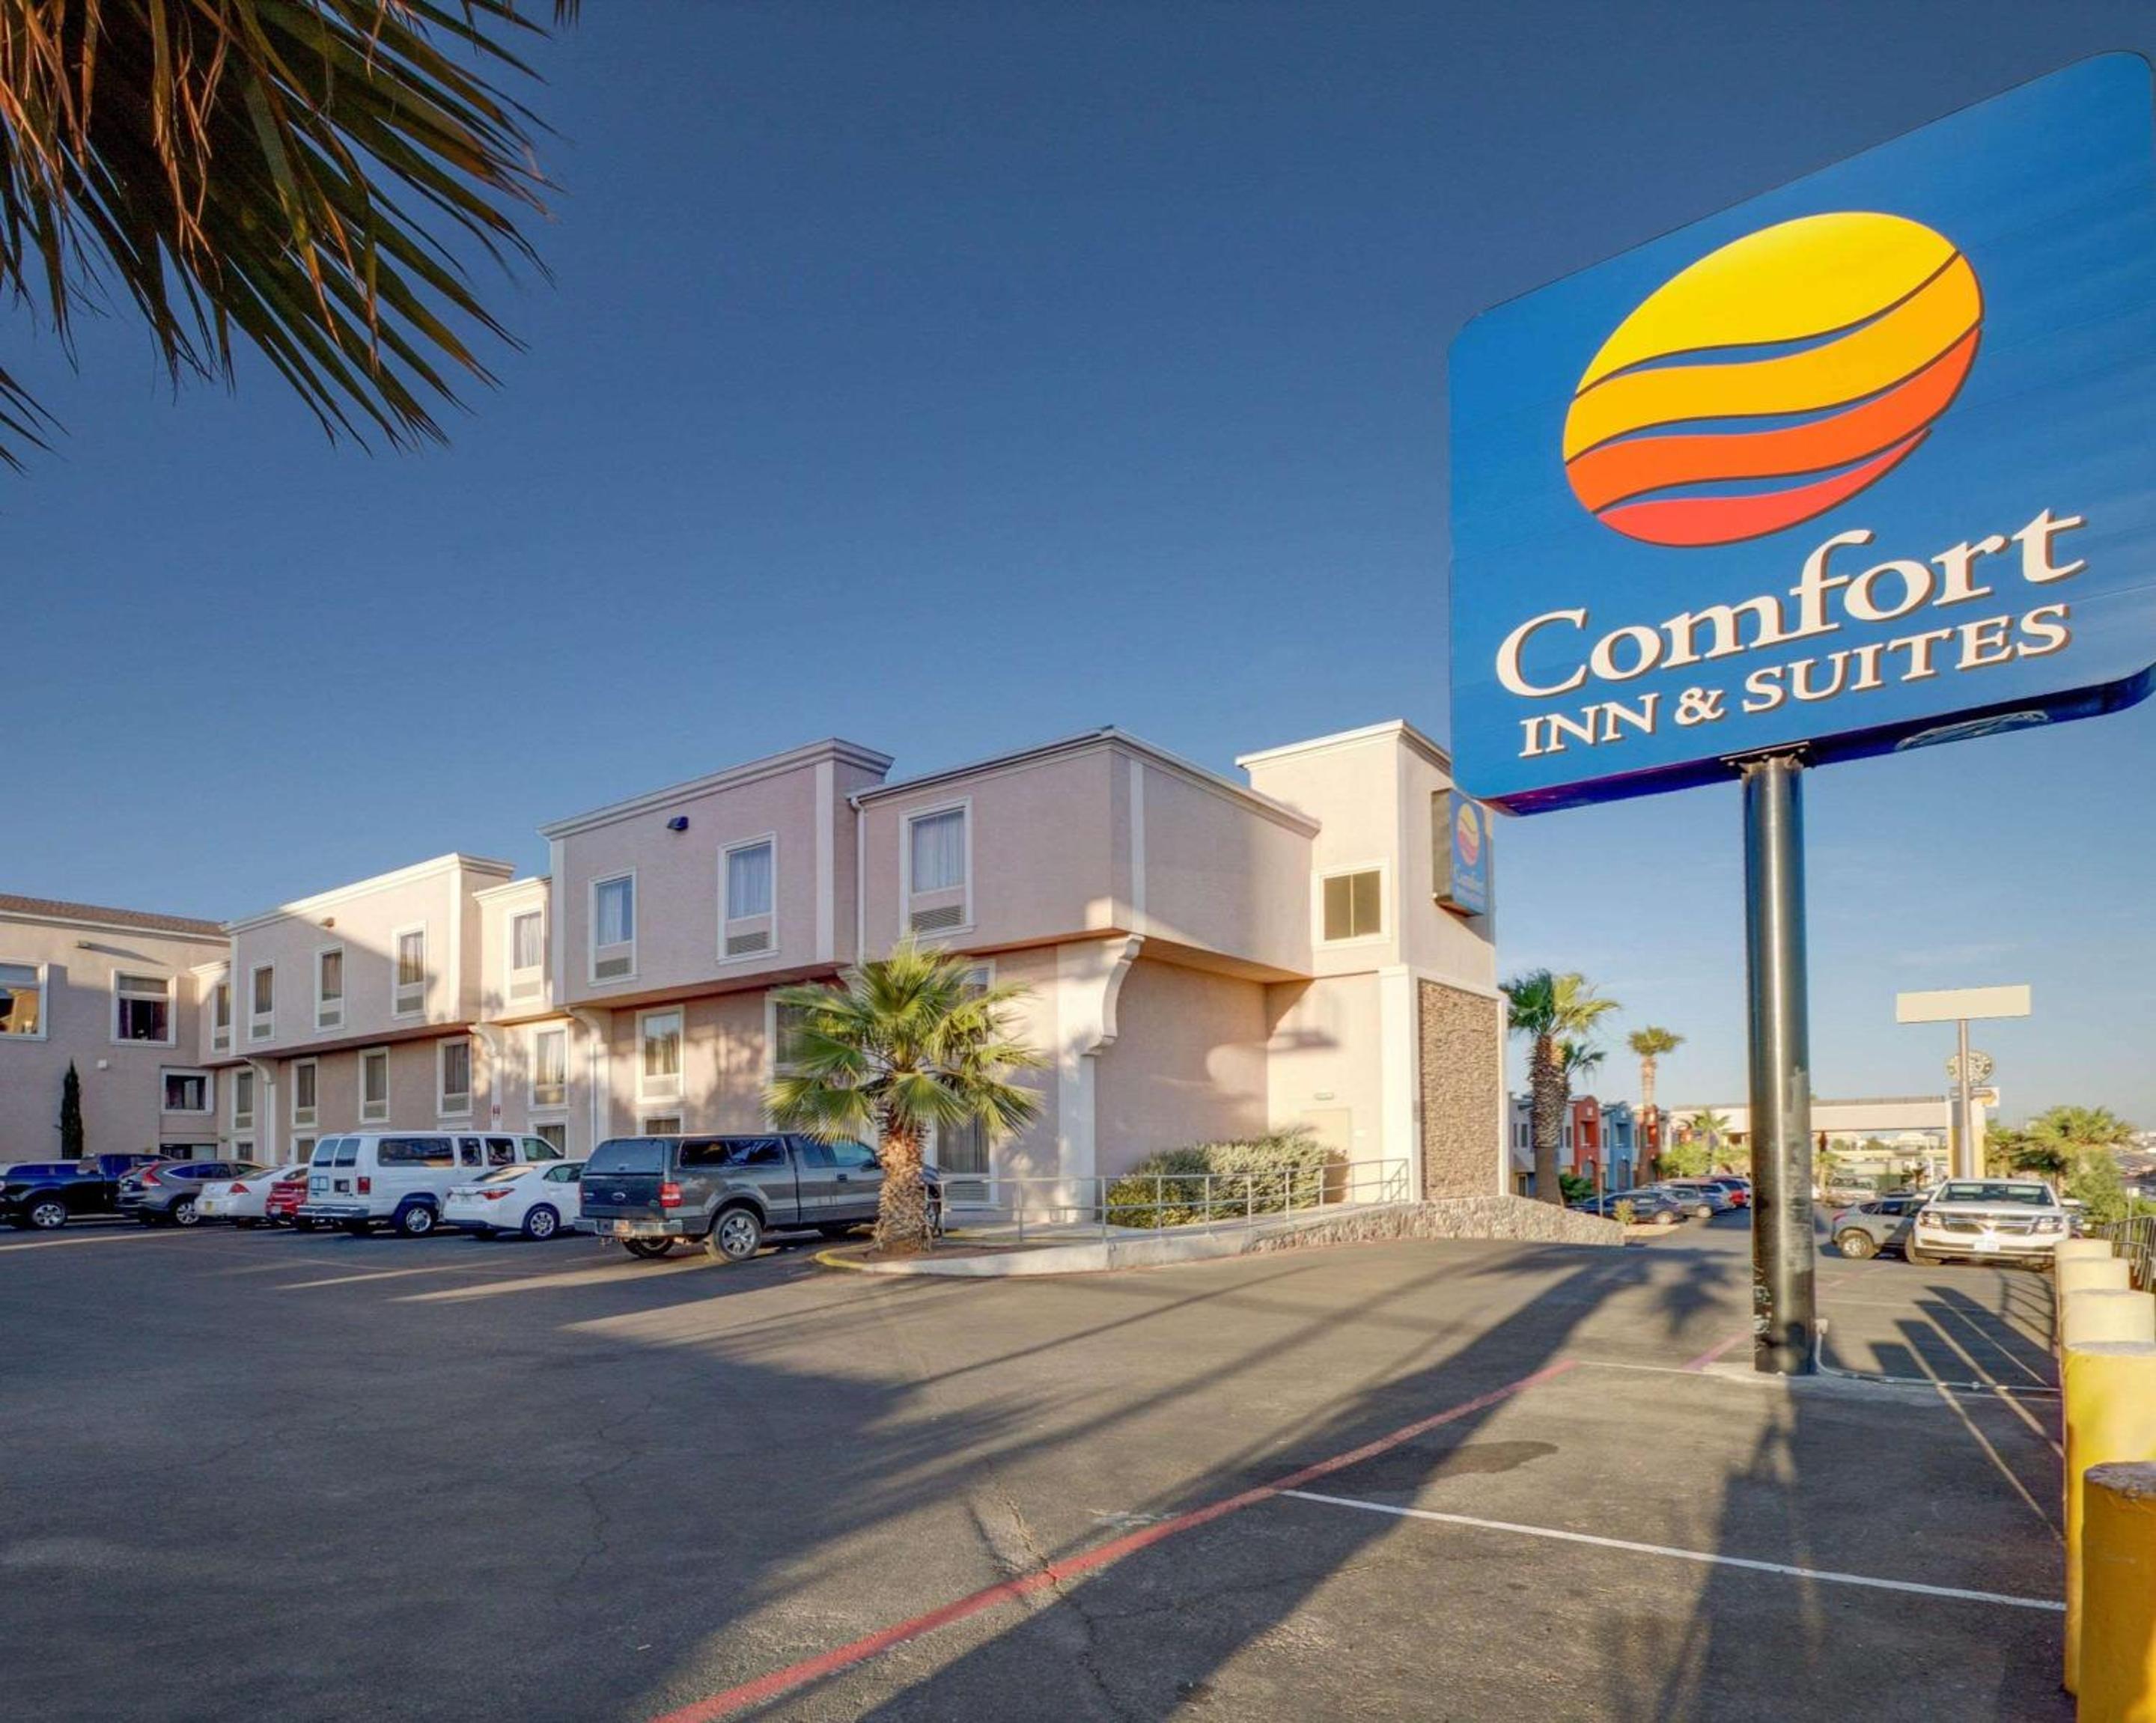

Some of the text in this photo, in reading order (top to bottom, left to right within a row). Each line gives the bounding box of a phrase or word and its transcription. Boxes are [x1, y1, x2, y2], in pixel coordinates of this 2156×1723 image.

[1496, 508, 2086, 697] Comfort
[1519, 603, 2070, 757] INN & SUITES
